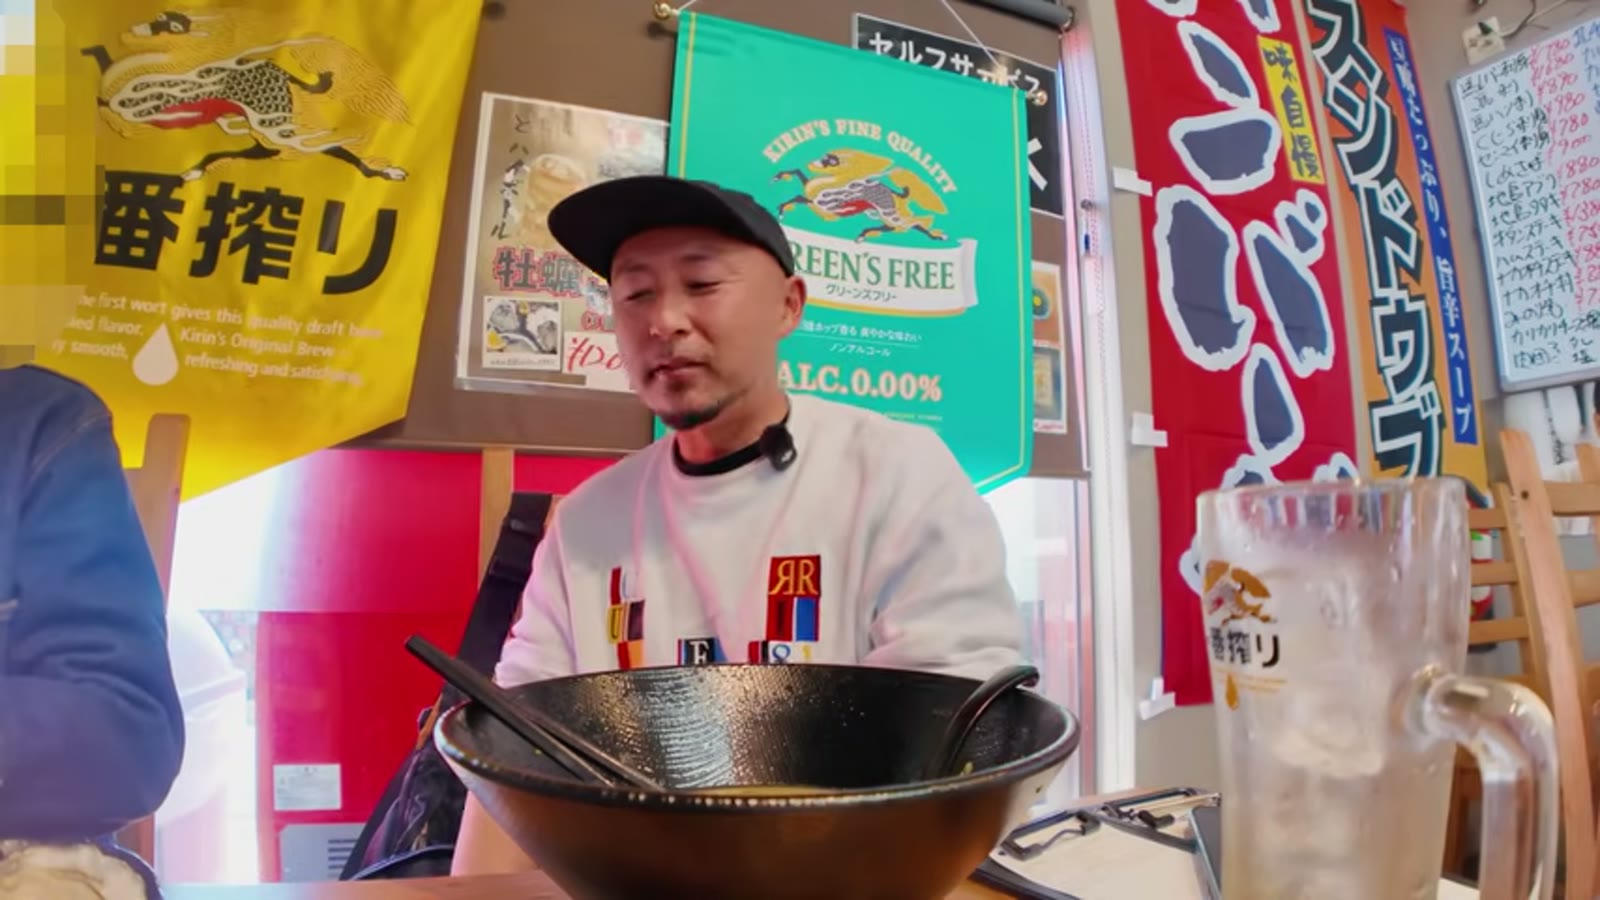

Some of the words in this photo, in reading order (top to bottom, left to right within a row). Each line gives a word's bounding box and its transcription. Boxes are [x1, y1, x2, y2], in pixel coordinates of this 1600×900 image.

[1262, 43, 1320, 179] 味自慢
[762, 119, 831, 163] KIRIN'S
[835, 118, 882, 141] FINE
[887, 131, 957, 193] QUALITY
[95, 170, 398, 294] 番搾り
[790, 240, 881, 286] REEN'S
[888, 258, 956, 290] FREE
[98, 292, 127, 311] first
[171, 304, 210, 321] gives
[216, 308, 243, 325] this
[306, 318, 343, 337] draft
[825, 284, 897, 302] グリーンズフリー
[180, 328, 227, 346] Kirin's
[231, 332, 293, 355] Original
[298, 341, 335, 357] Brew
